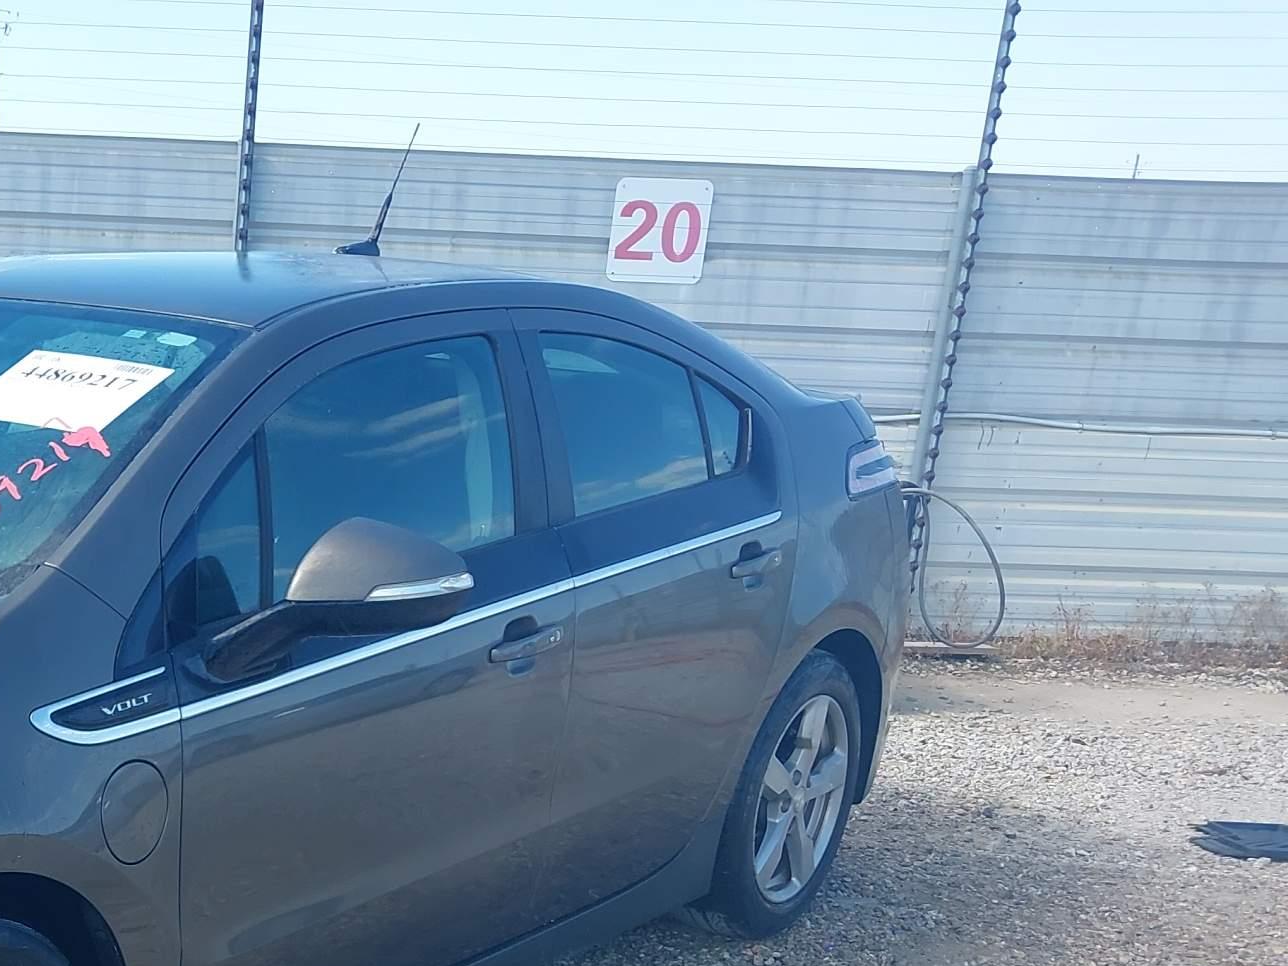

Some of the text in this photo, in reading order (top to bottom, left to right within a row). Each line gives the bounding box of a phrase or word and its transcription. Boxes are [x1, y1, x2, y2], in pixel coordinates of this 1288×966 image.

[614, 199, 702, 263] 20
[21, 365, 139, 391] 44869217
[101, 692, 154, 716] VOLT
